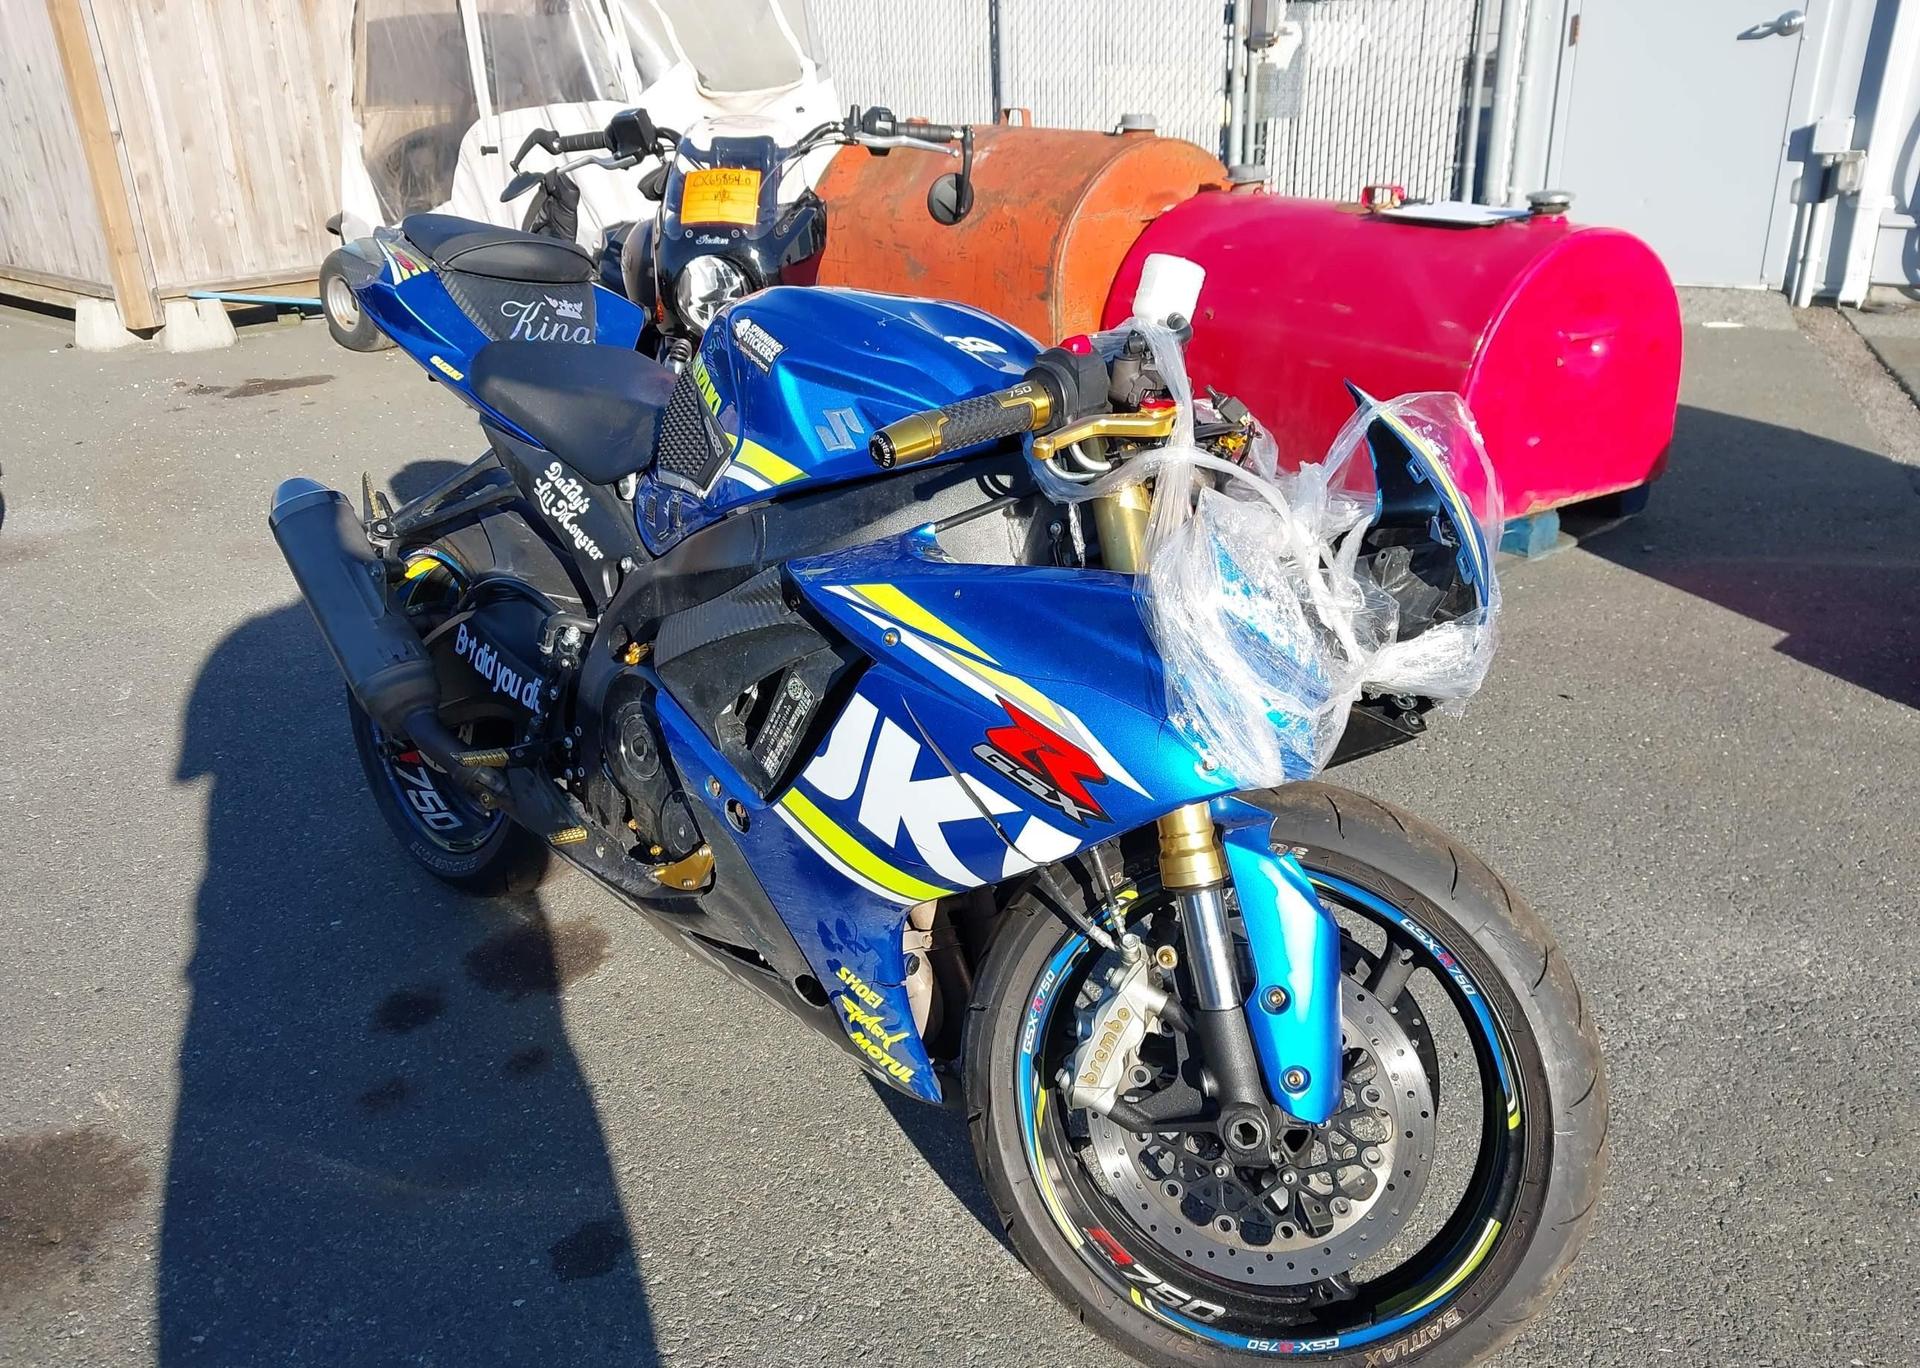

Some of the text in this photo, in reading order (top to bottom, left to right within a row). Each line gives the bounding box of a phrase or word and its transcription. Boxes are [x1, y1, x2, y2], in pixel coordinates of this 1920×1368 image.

[743, 332, 777, 363] STICKERS
[749, 323, 784, 353] SPINNING
[1007, 385, 1033, 398] 750
[544, 461, 591, 514] Daddy's
[550, 499, 604, 561] Monster
[474, 643, 498, 680] did
[492, 661, 522, 700] you
[394, 749, 463, 831] 750
[836, 966, 885, 1010] SHOEI
[850, 1031, 916, 1084] MOTUL
[1079, 1007, 1131, 1085] brembo
